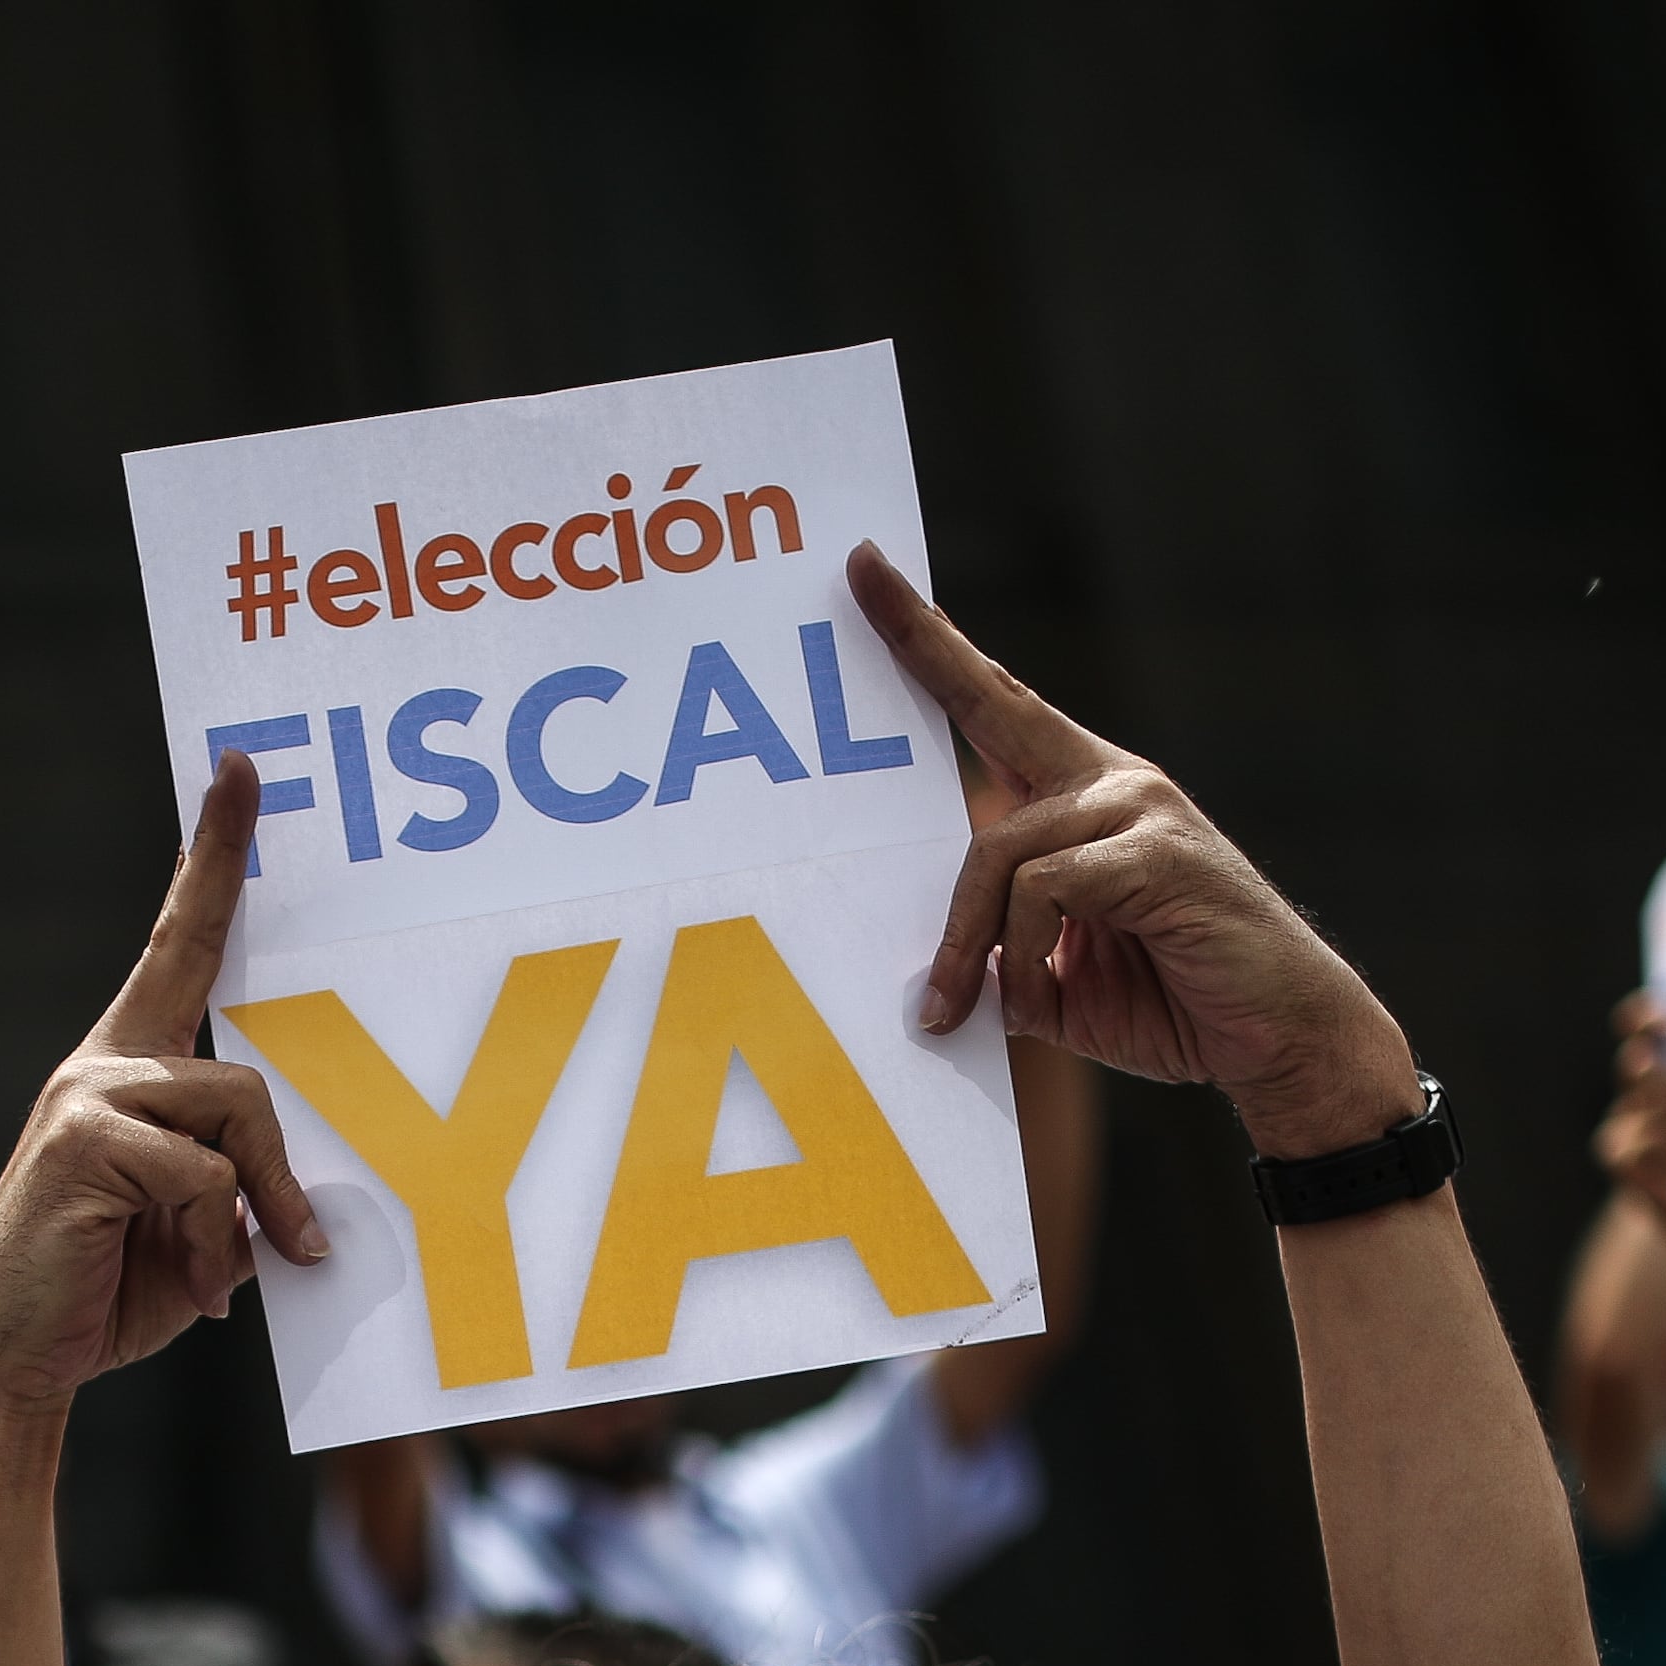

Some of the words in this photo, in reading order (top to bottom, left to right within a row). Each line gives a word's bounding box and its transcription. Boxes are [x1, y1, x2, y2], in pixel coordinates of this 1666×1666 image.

[226, 463, 803, 643] #elección
[204, 618, 915, 879] FISCAL
[219, 914, 994, 1391] YA
